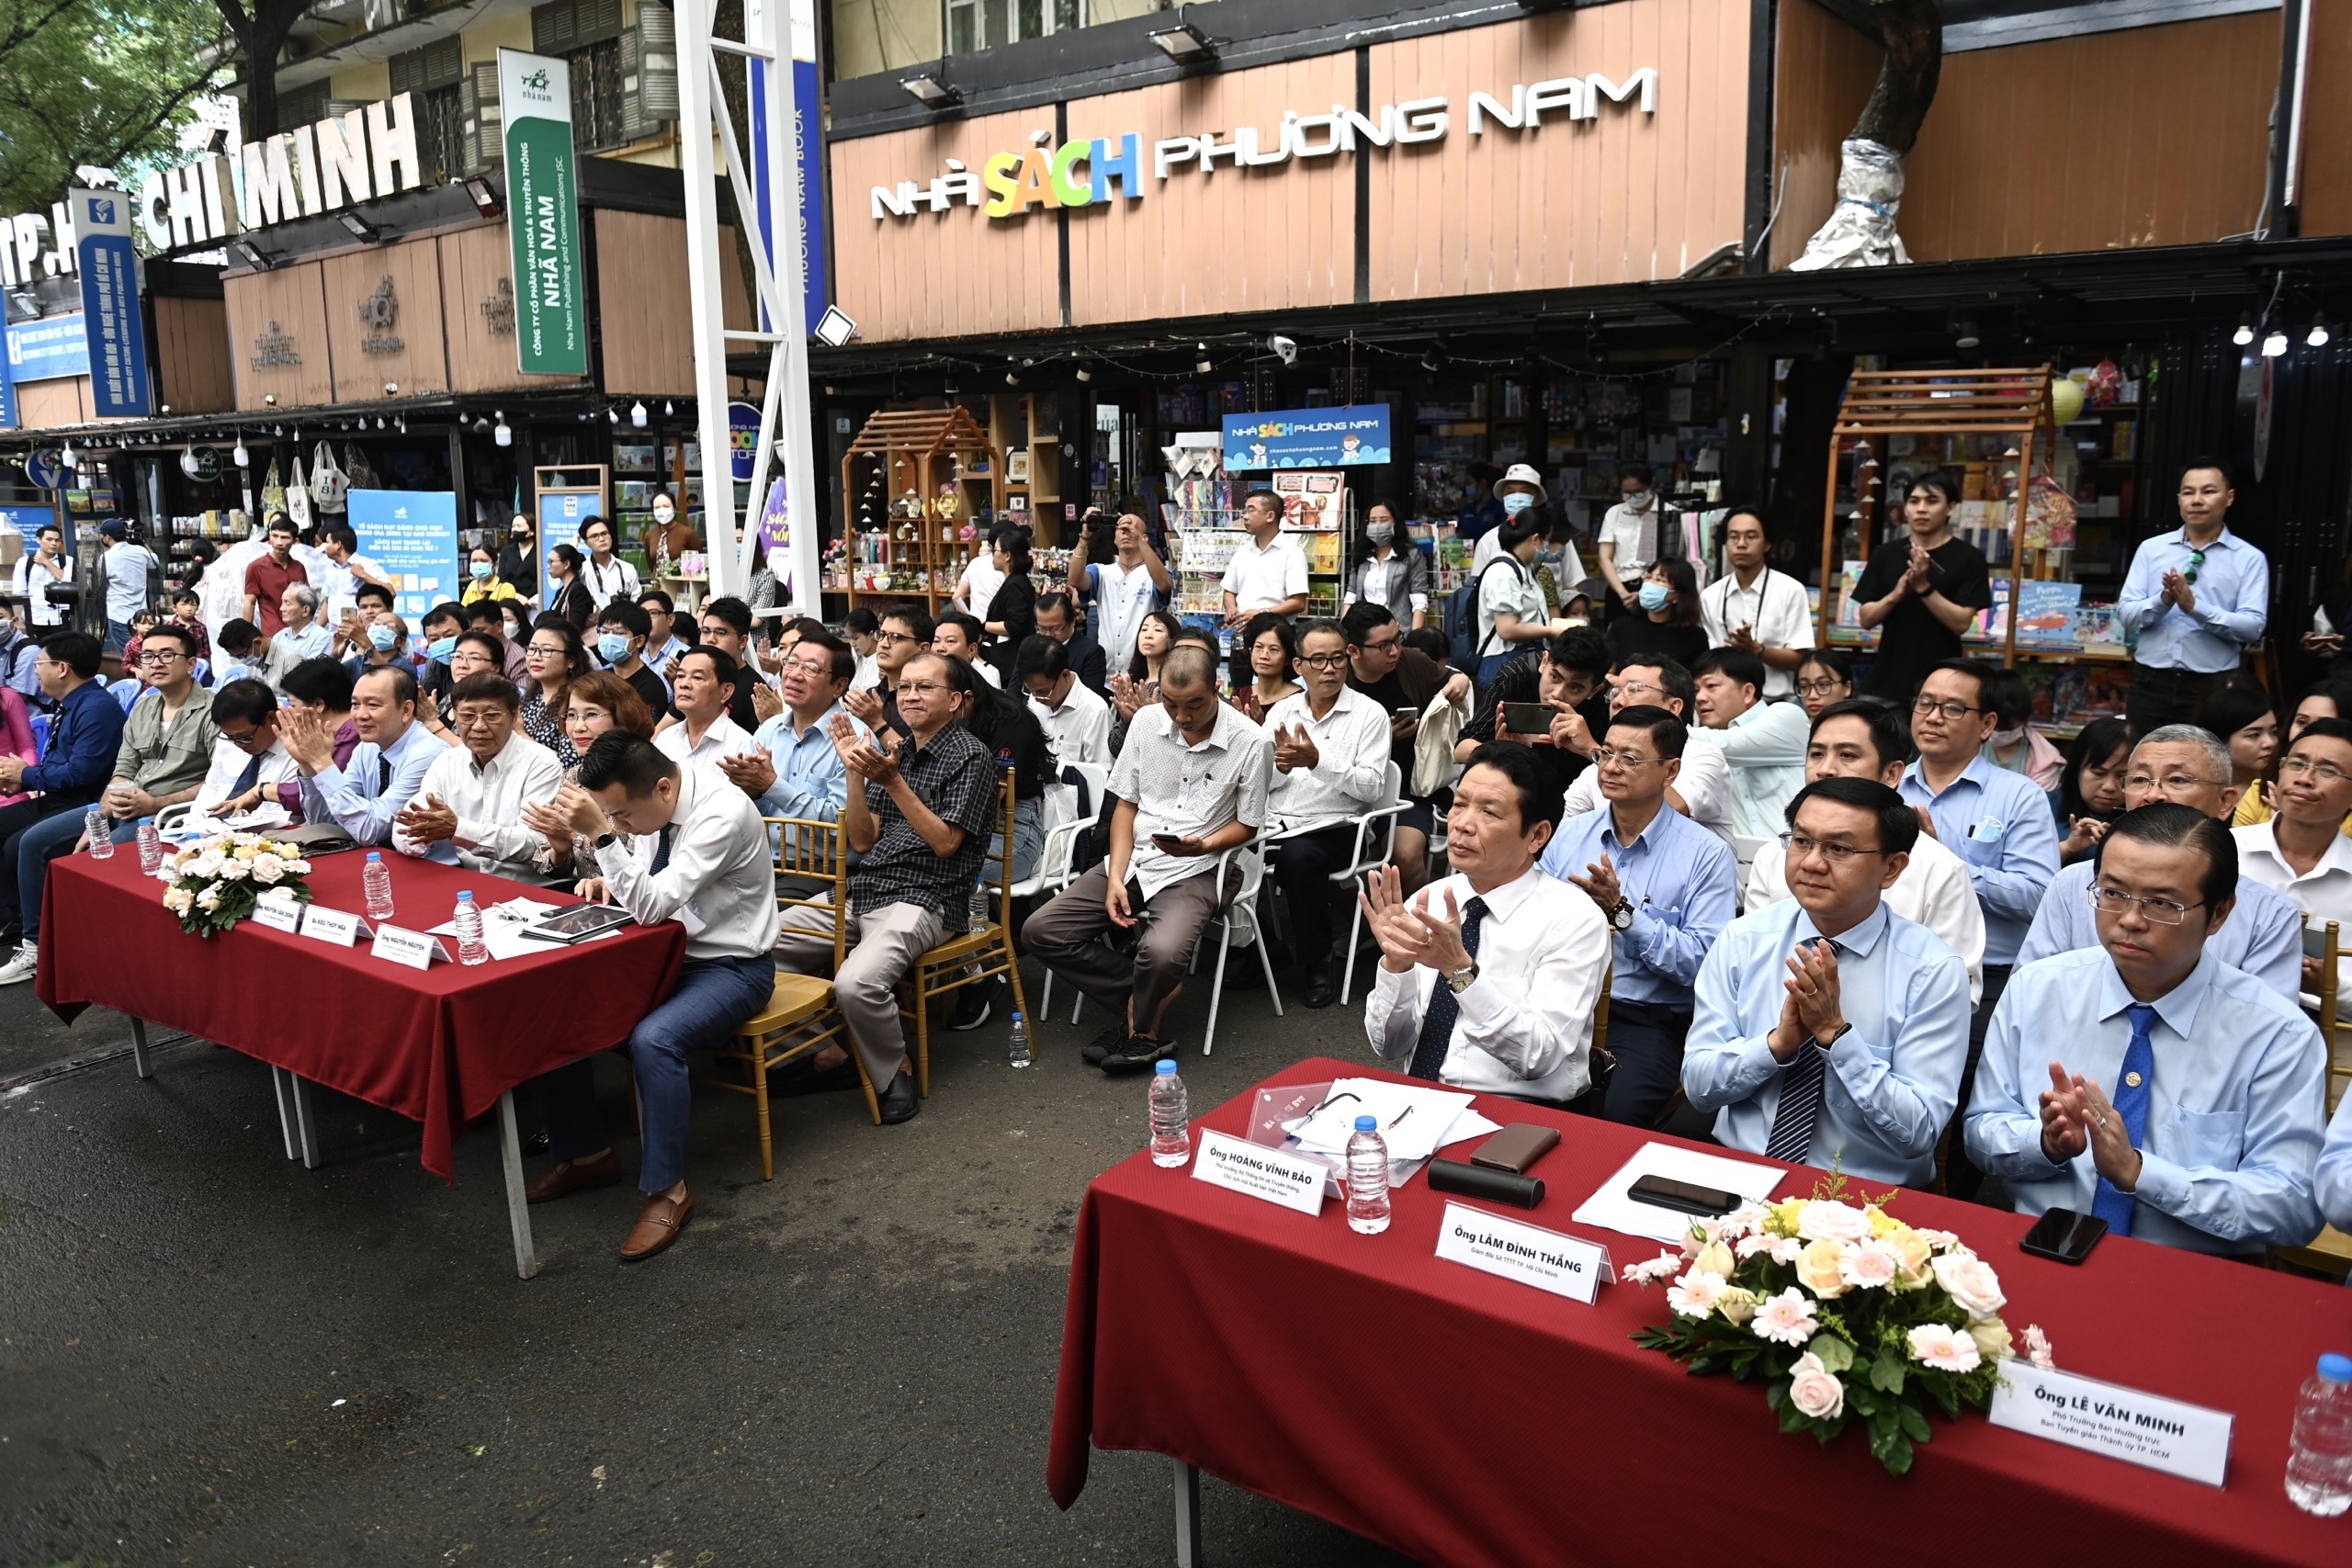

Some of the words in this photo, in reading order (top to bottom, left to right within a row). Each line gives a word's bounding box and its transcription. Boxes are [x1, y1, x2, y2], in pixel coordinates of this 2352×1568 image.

[520, 141, 530, 176] THÔNG
[871, 158, 979, 219] NHÀ
[983, 130, 1144, 218] SÁCH
[1154, 96, 1450, 179] PHƯƠNG
[1468, 66, 1657, 134] NAM
[142, 128, 237, 250] CHÍ
[242, 90, 421, 230] MINH
[537, 195, 557, 251] NAM
[556, 173, 568, 244] Communications
[525, 228, 535, 248] HOÁ
[560, 246, 569, 264] and
[538, 256, 560, 307] NHÃ
[563, 264, 571, 309] Publishing
[533, 315, 540, 327] TY
[532, 329, 542, 356] CÔNG
[1232, 425, 1257, 436] NHÀ
[1259, 421, 1294, 438] SÁCH
[1350, 420, 1378, 429] NAM
[1210, 1145, 1227, 1161] Ông
[1229, 1153, 1262, 1170] HOÀNG
[1265, 1163, 1290, 1178] VĨNH
[1291, 1171, 1312, 1185] BẢO
[1454, 1224, 1476, 1243] Ông
[1479, 1234, 1504, 1249] LÂM
[1506, 1242, 1537, 1259] ĐÌNH
[1540, 1252, 1582, 1273] THẮNG
[1517, 1260, 1525, 1269] TP.
[1544, 1269, 1558, 1279] Minh
[2034, 1384, 2065, 1408] Ông
[2071, 1395, 2089, 1411] LÊ
[2094, 1402, 2130, 1422] VĂN
[2135, 1413, 2185, 1437] MINH
[2052, 1410, 2067, 1420] Phó
[2098, 1423, 2112, 1432] Ban
[2114, 1427, 2143, 1443] thường
[2041, 1418, 2054, 1427] Ban
[2056, 1422, 2079, 1434] Tuyên
[2080, 1429, 2098, 1440] giáo
[2099, 1434, 2123, 1448] Thành
[2136, 1444, 2148, 1454] TP.
[2150, 1448, 2170, 1460] HCM
